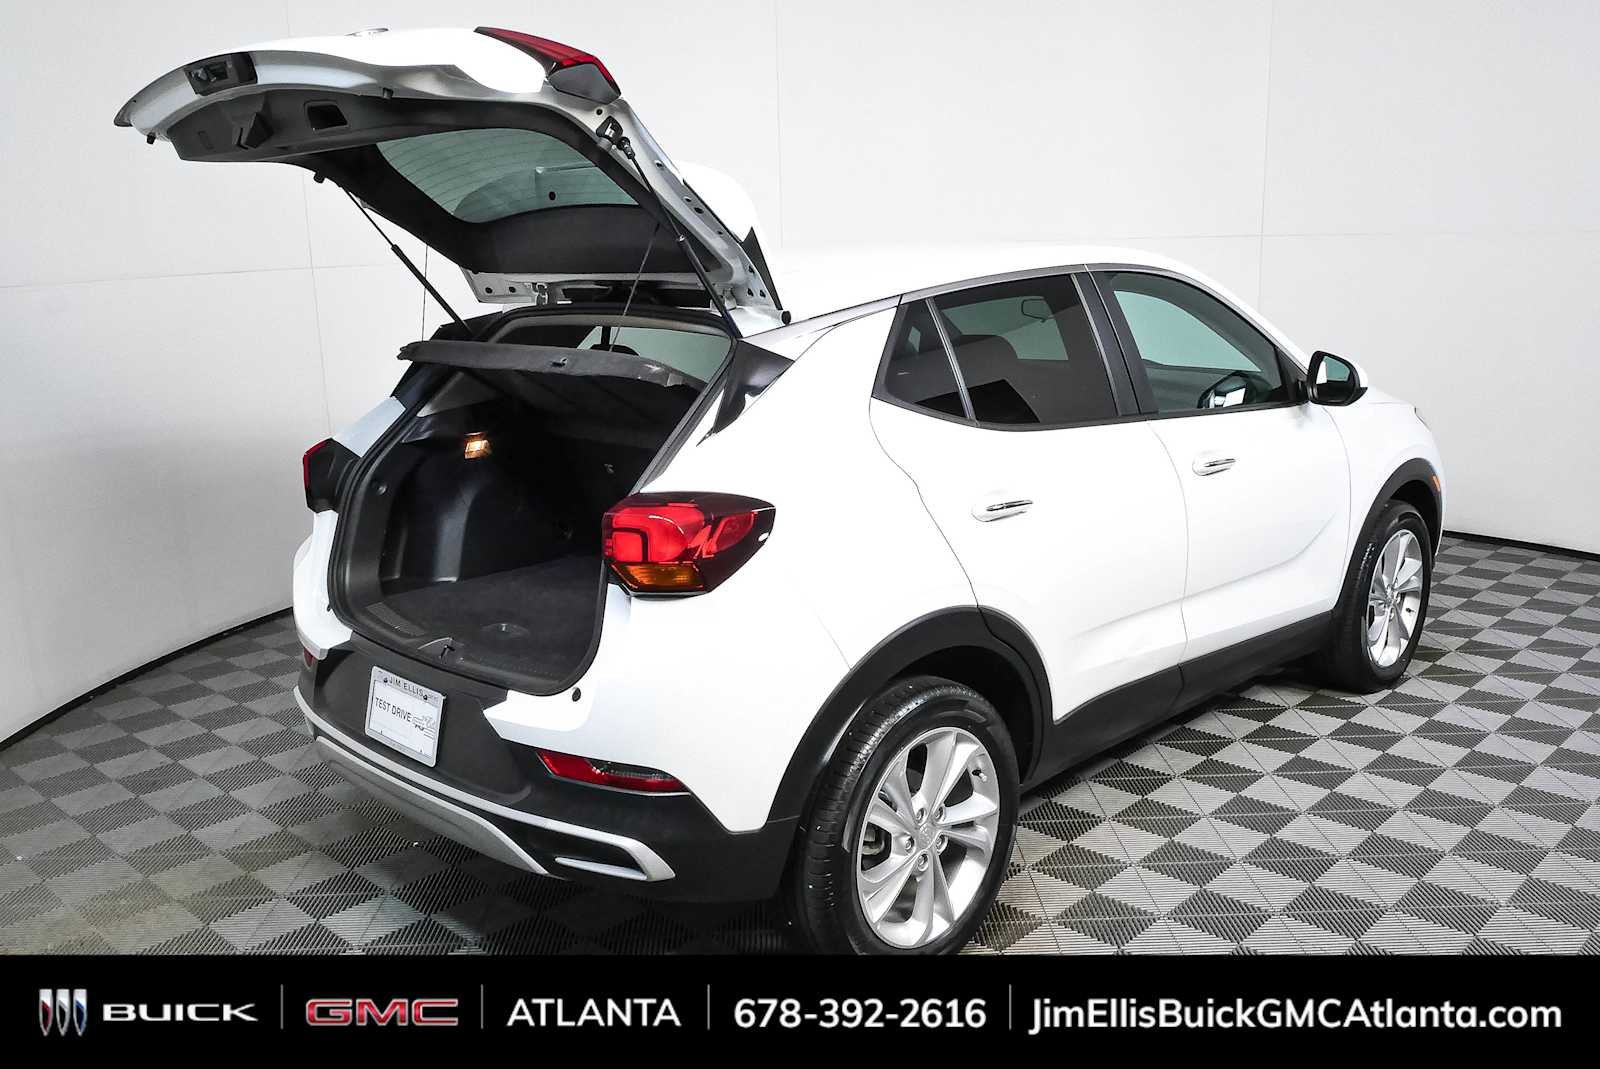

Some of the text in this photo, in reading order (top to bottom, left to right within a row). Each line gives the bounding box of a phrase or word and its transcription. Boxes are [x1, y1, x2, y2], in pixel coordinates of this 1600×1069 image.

[388, 676, 402, 687] JIM
[403, 682, 424, 697] ELLIS
[375, 697, 391, 712] TEST
[391, 705, 412, 723] DRIVE
